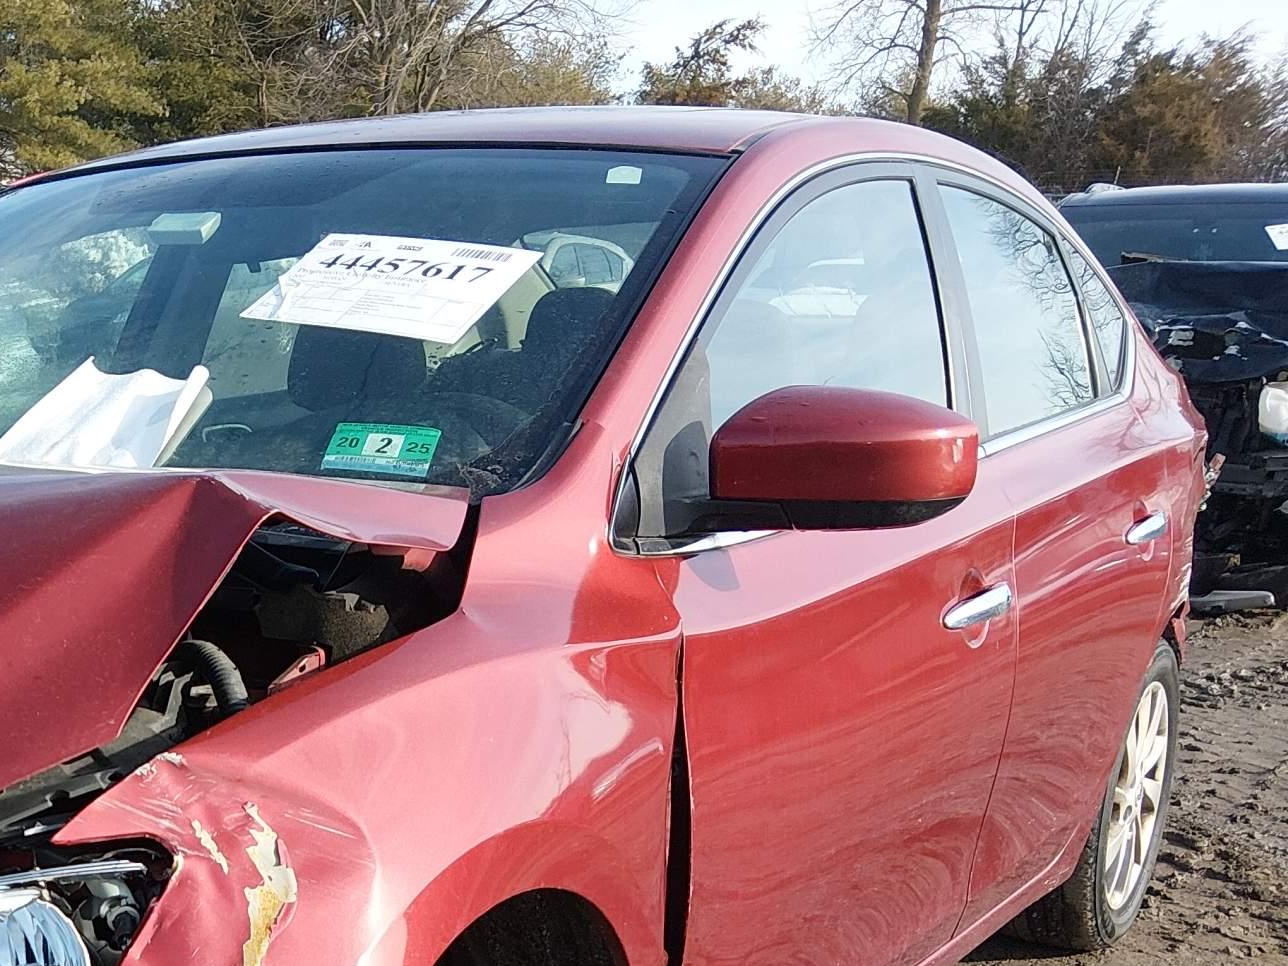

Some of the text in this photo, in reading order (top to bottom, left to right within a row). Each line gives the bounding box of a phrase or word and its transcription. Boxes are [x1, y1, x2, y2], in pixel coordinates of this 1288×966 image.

[319, 253, 494, 283] 44457617
[337, 437, 431, 454] 20 2 25
